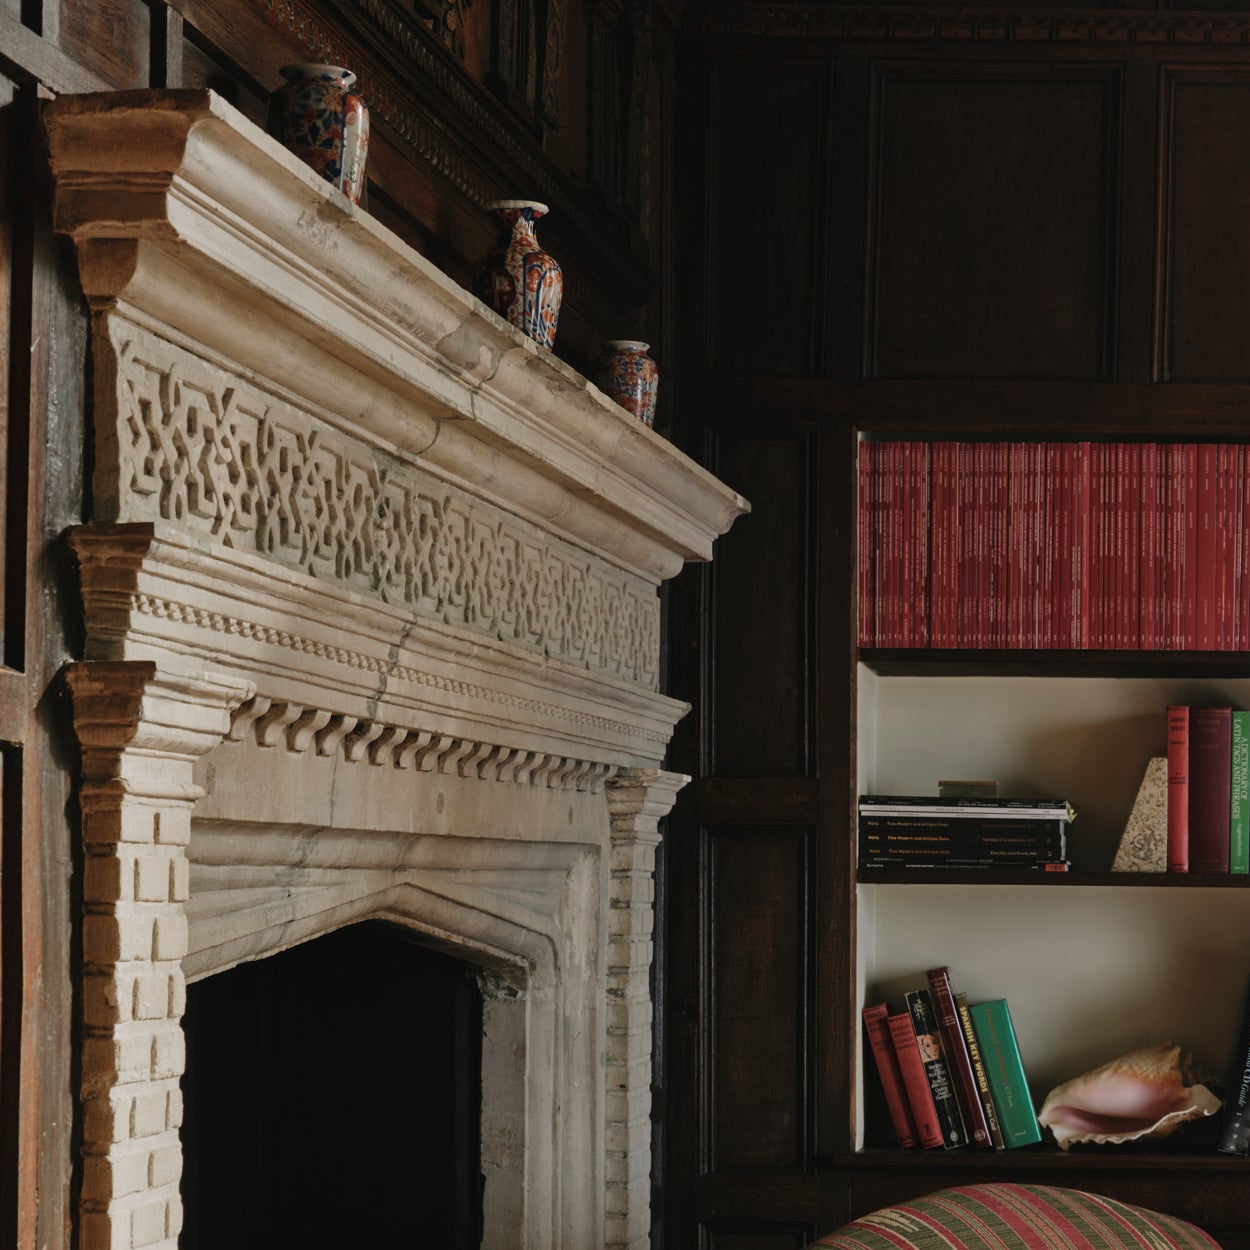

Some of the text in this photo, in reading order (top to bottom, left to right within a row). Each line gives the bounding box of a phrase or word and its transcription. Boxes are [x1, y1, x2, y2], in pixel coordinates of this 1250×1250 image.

[1233, 744, 1241, 764] TAGS
[1240, 743, 1248, 789] DICTIONARY
[1232, 784, 1240, 820] PHRASES
[1240, 790, 1248, 800] OF
[960, 1006, 988, 1092] SPANISH KEY WORDS
[1238, 1084, 1250, 1107] Guide
